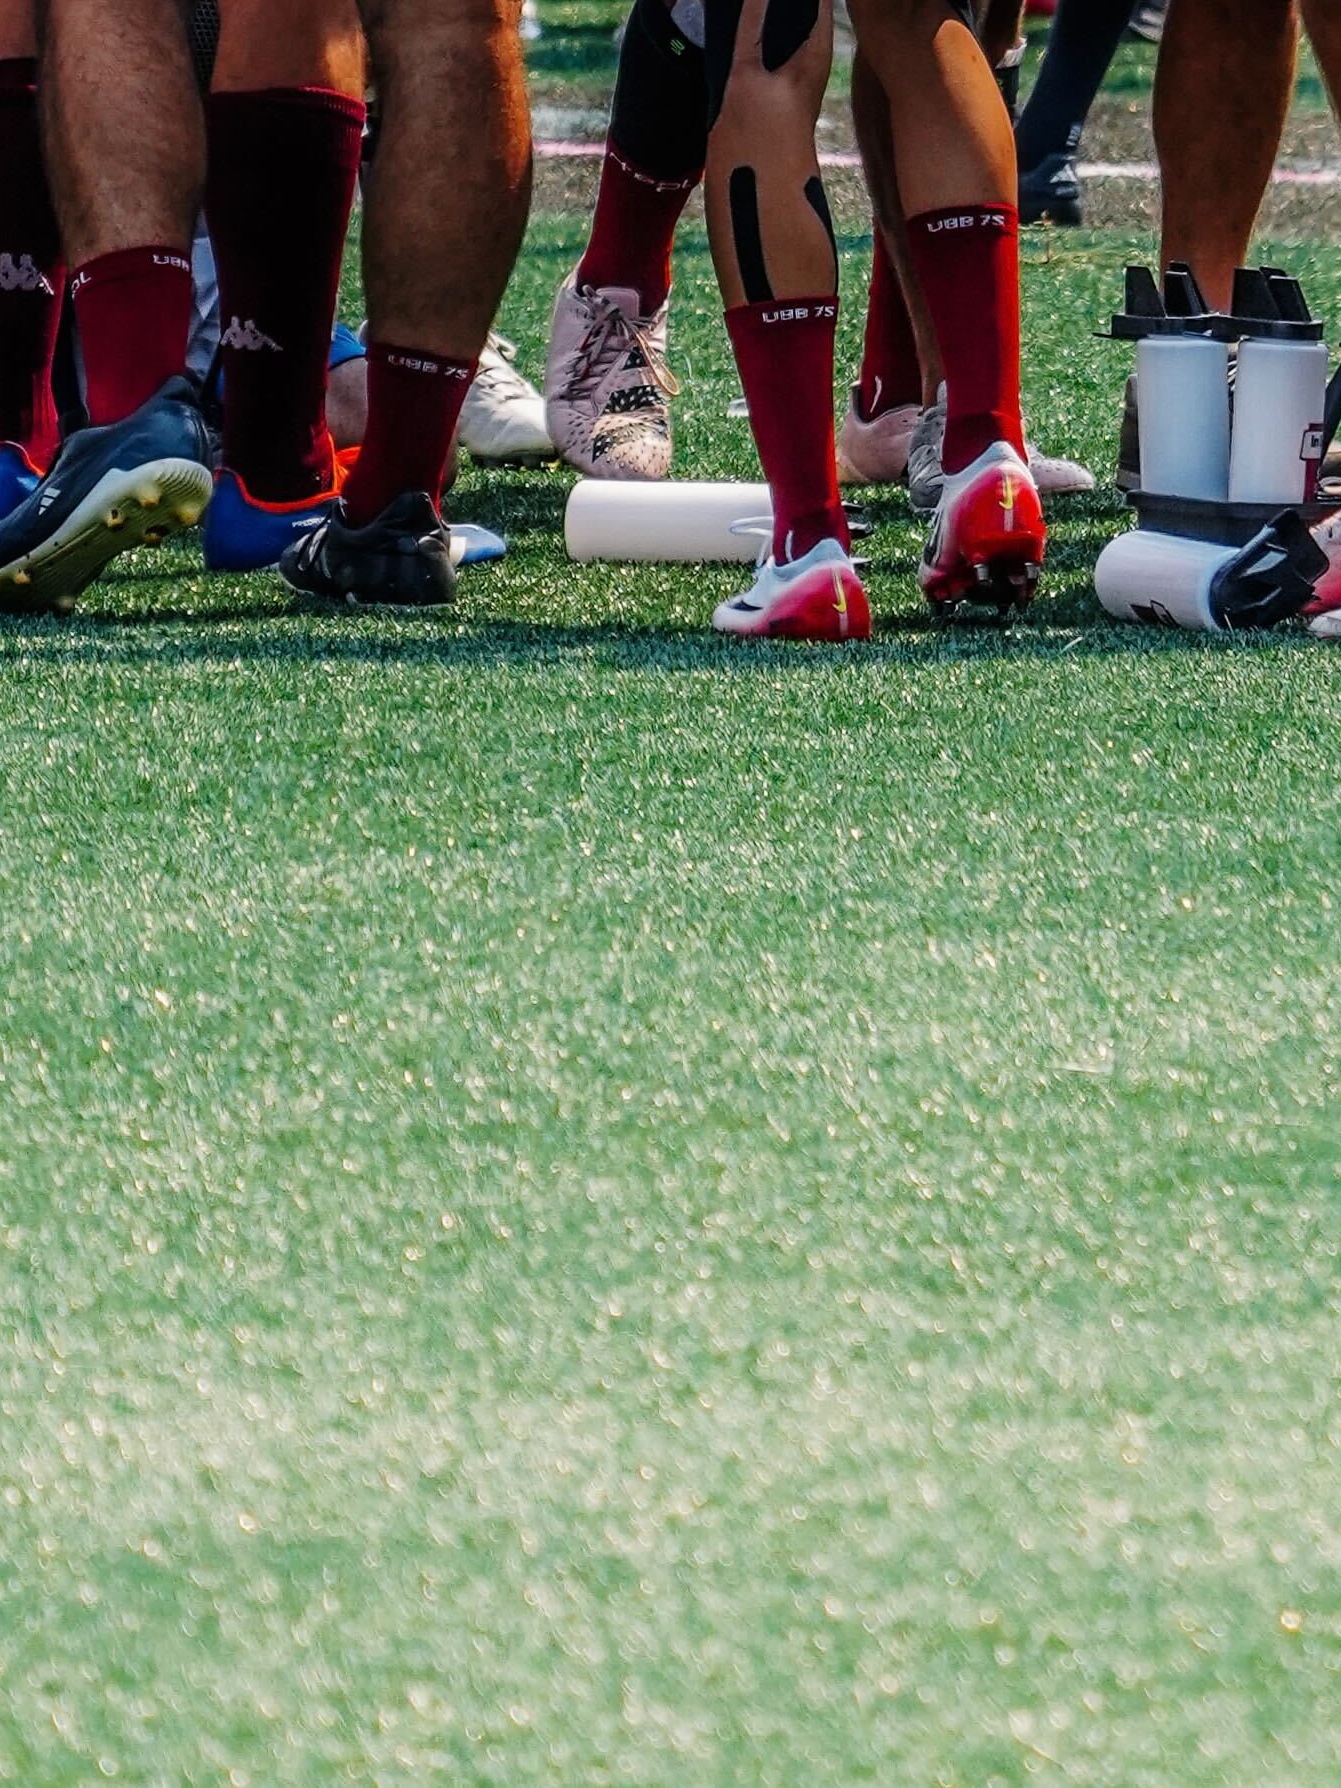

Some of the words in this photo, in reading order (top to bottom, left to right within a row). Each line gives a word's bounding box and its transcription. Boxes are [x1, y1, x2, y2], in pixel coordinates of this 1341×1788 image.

[927, 213, 974, 233] UBB
[762, 308, 809, 324] UBB
[387, 352, 440, 374] UBB
